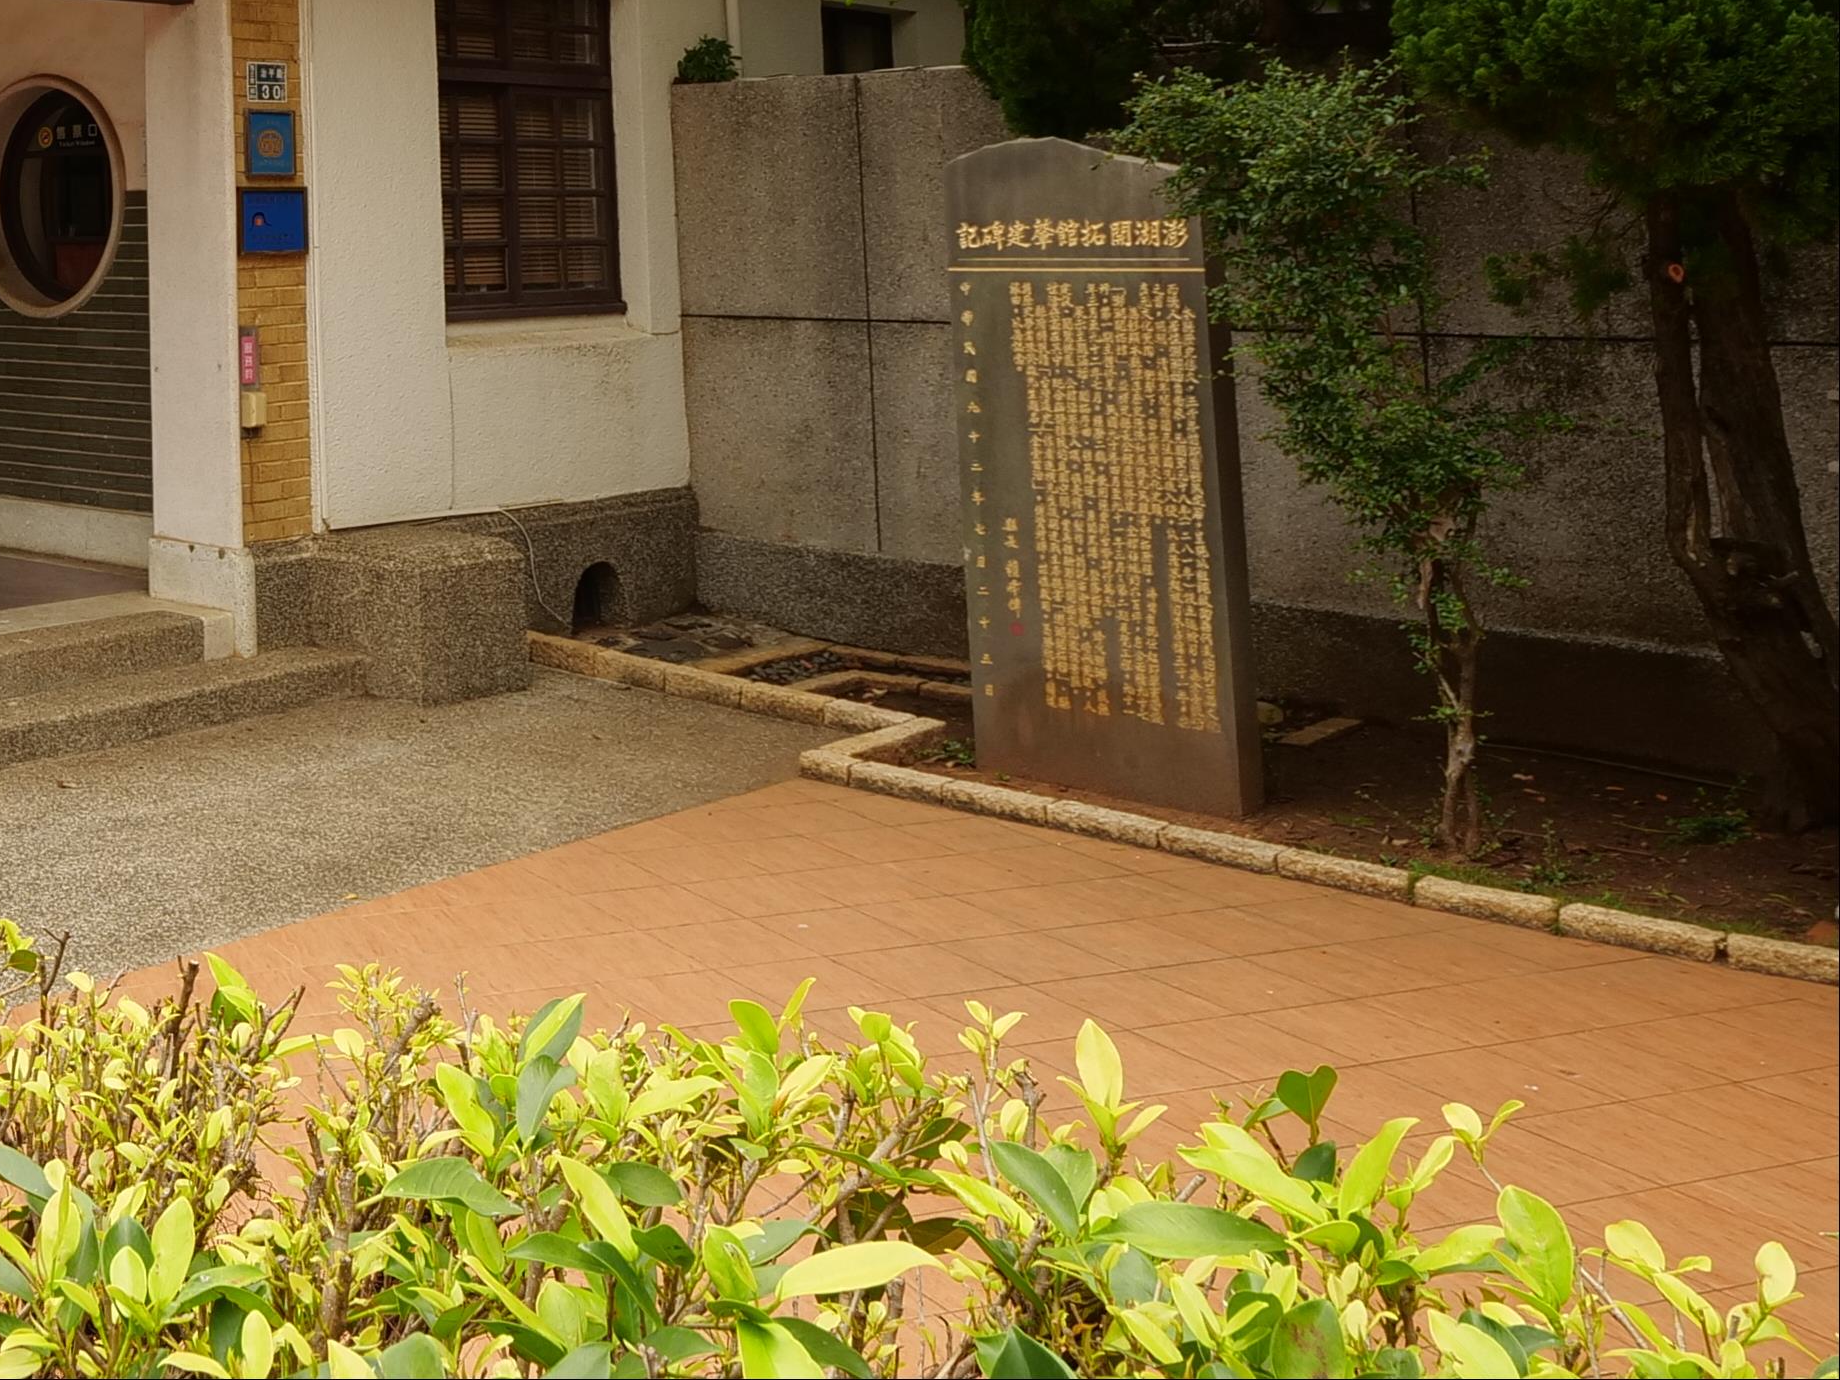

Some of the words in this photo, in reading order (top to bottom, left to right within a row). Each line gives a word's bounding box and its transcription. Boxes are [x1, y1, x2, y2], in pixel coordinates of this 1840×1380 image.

[261, 84, 281, 99] 30
[56, 124, 98, 139] 售票口
